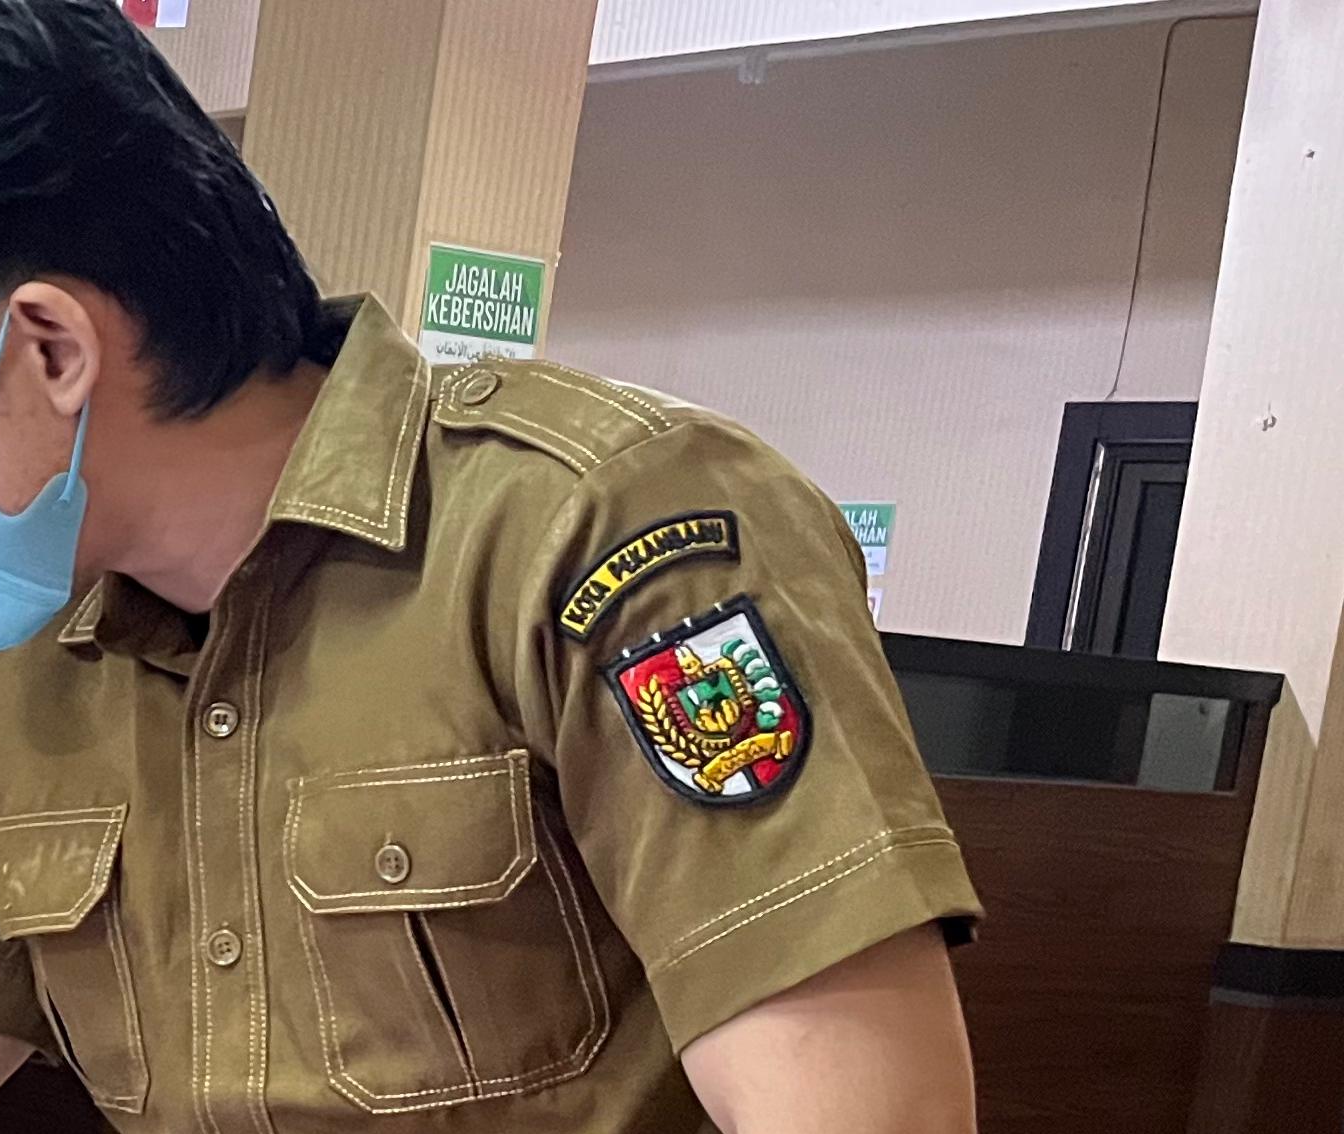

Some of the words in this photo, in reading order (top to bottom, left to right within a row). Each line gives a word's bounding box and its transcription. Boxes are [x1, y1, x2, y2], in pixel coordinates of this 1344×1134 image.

[445, 263, 523, 303] JAGALAH
[427, 292, 534, 336] KEBERSIHAN
[563, 579, 612, 626] KOTA
